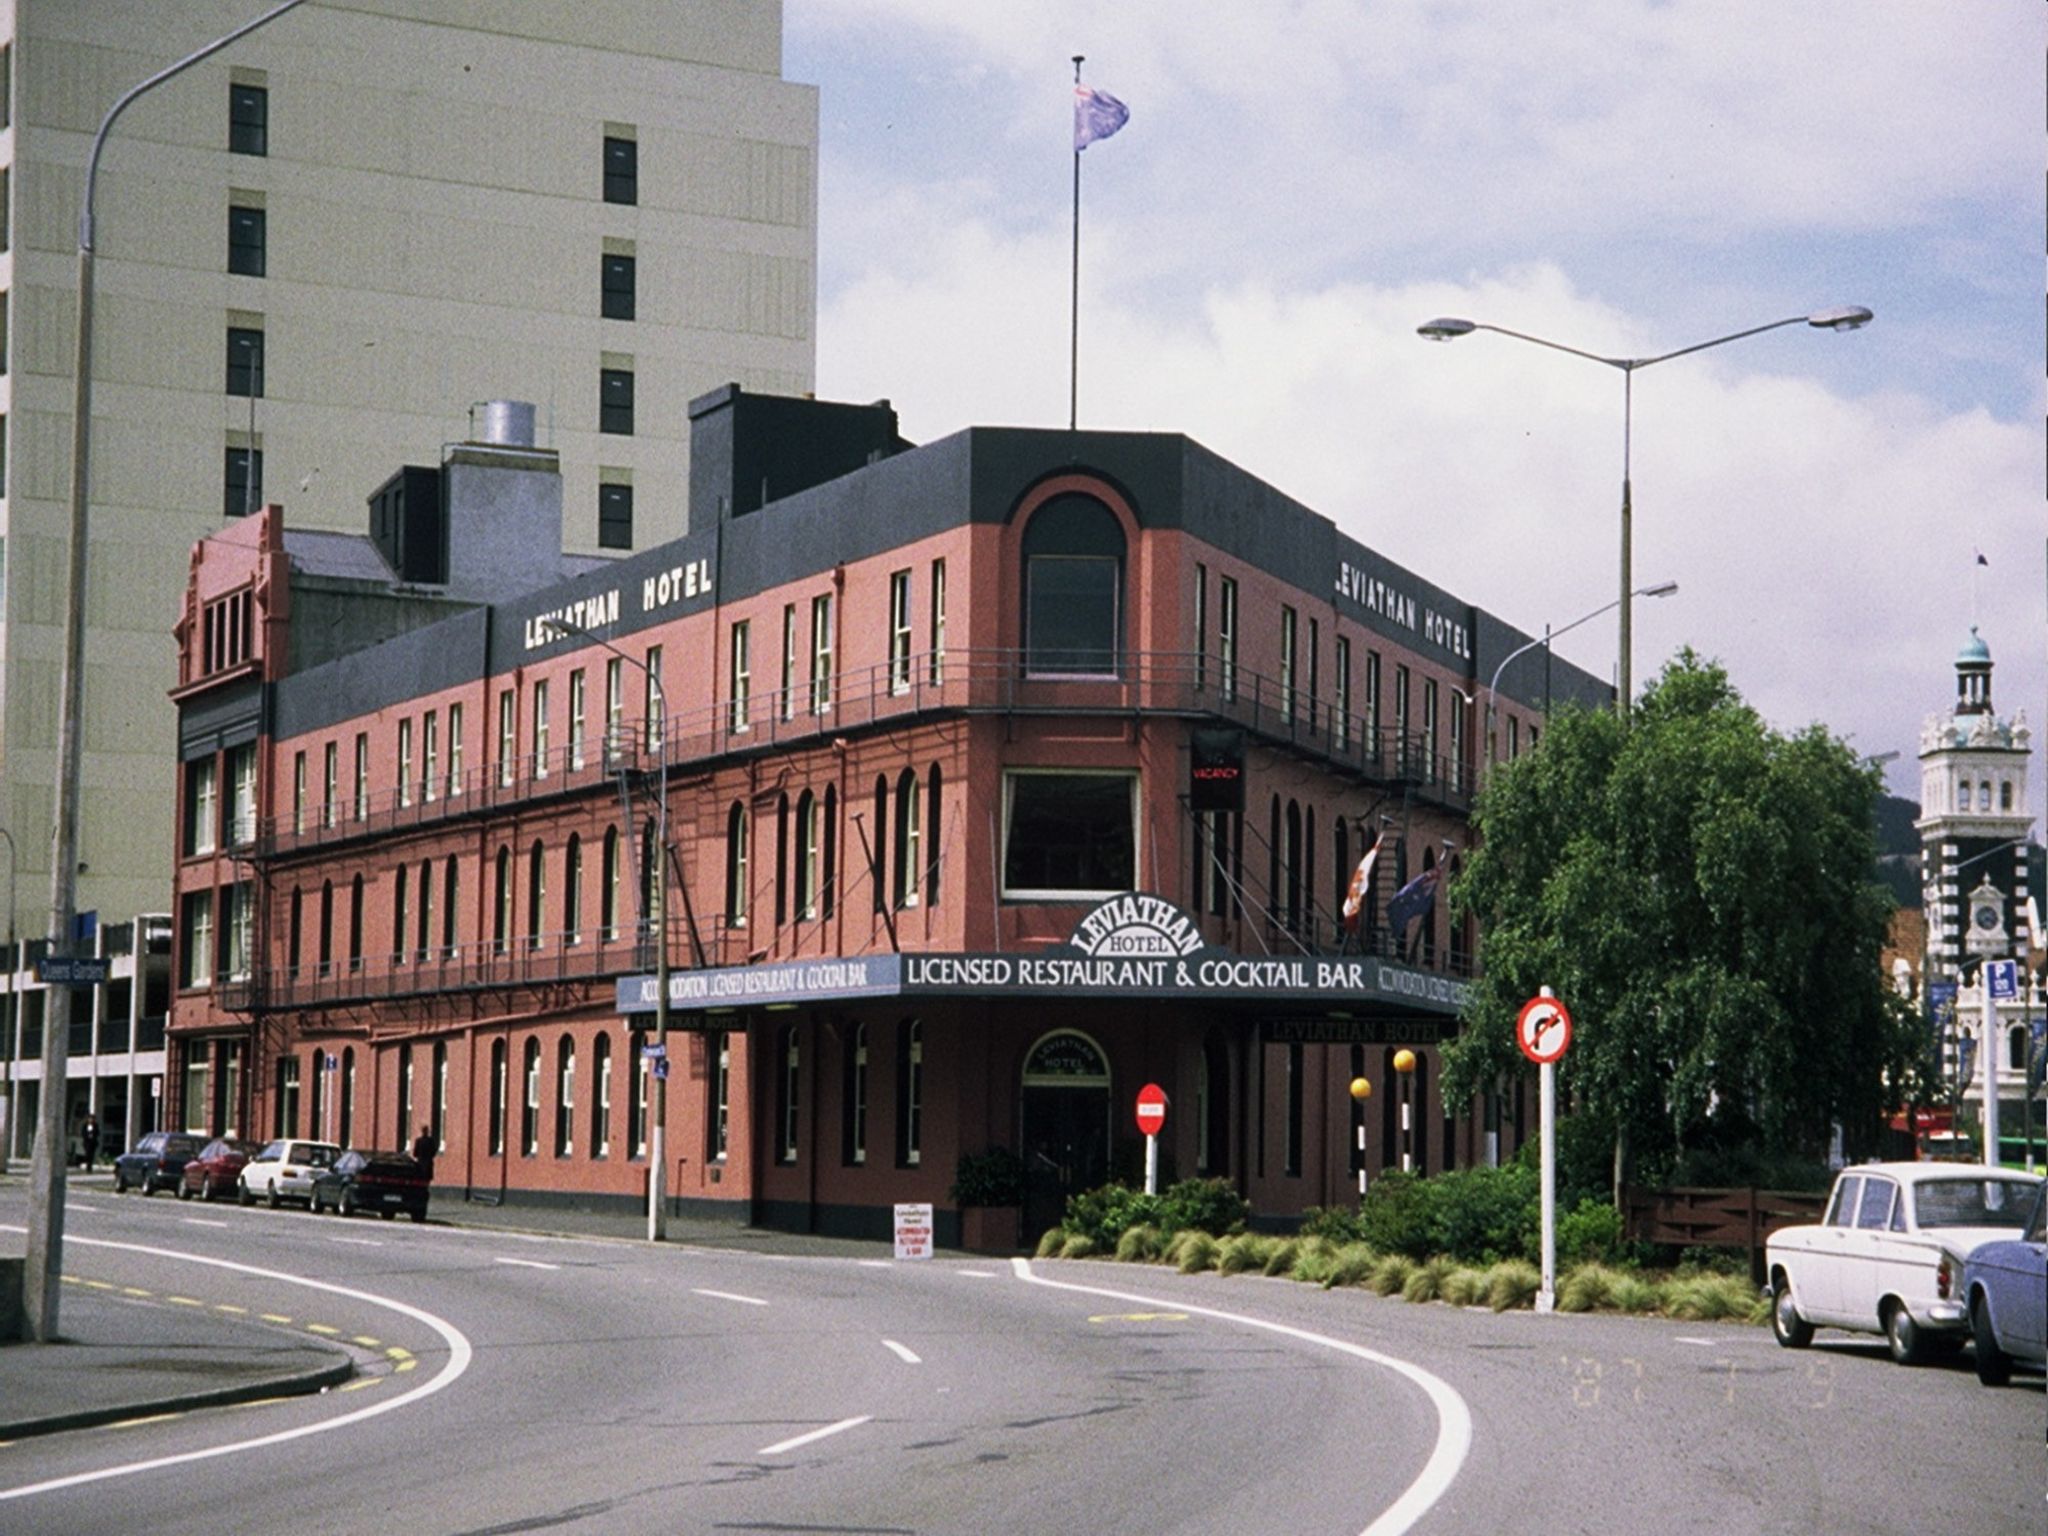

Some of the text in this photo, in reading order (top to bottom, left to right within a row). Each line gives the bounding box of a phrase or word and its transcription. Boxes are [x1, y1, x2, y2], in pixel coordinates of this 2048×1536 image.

[643, 559, 712, 611] HOTEL
[1425, 609, 1470, 660] HOTEL
[1193, 767, 1239, 779] VACANCY
[1070, 896, 1204, 956] LEVIATHAN
[1110, 936, 1168, 953] HOTEL
[908, 959, 1364, 988] LICENSED RESTAURANT & COCKTAIL BAR
[1995, 964, 2007, 978] P
[1272, 1021, 1377, 1041] LEVIATHAN
